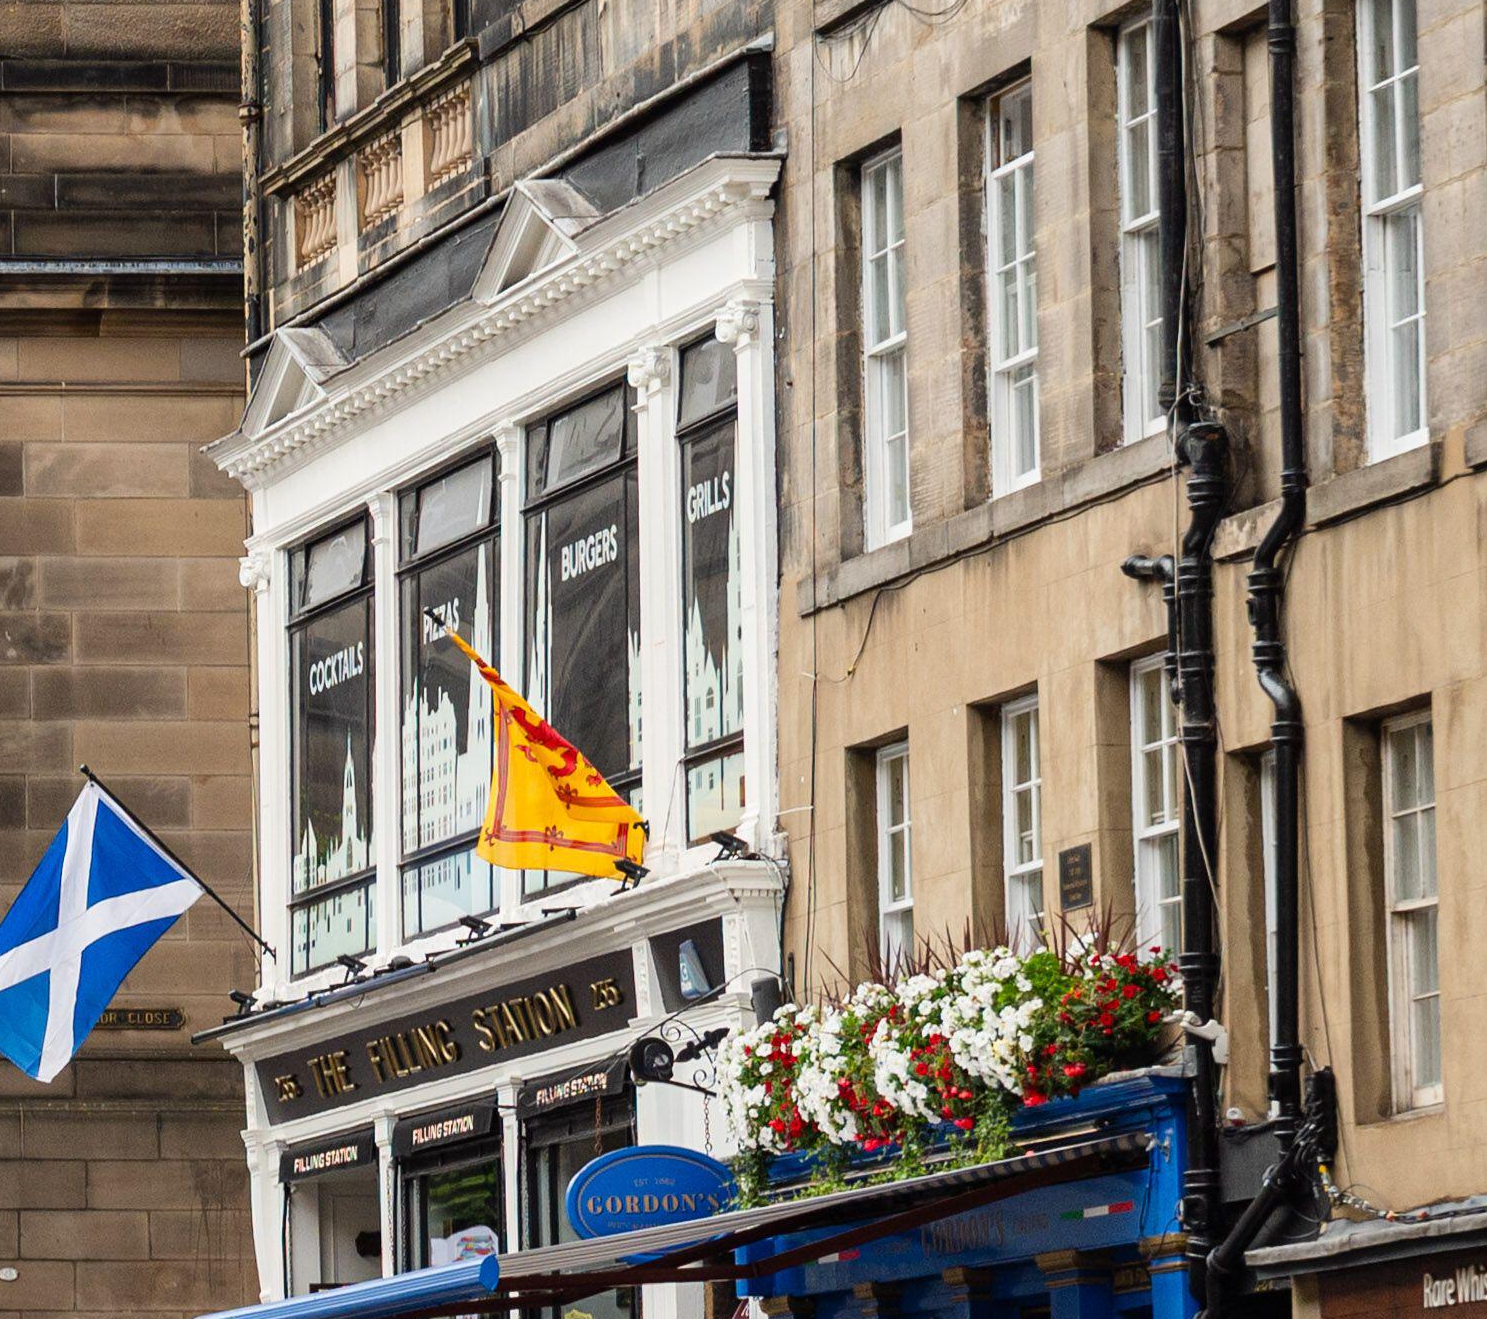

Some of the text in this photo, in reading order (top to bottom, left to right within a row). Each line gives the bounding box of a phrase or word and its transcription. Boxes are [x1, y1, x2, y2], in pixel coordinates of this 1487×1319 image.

[686, 471, 730, 524] GRILLS
[561, 524, 618, 581] BURGERS
[309, 641, 364, 696] COCKTAILS
[128, 1013, 170, 1024] CLOSE
[307, 1051, 357, 1099] THE
[366, 1019, 460, 1082] FILLING
[472, 984, 578, 1051] STATION
[536, 1073, 607, 1105] FILLING STATION
[412, 1114, 474, 1146] FILLING STATION
[294, 1145, 358, 1173] FILLING STATION
[587, 1191, 720, 1215] GORDON'S
[1424, 1273, 1455, 1308] Rare
